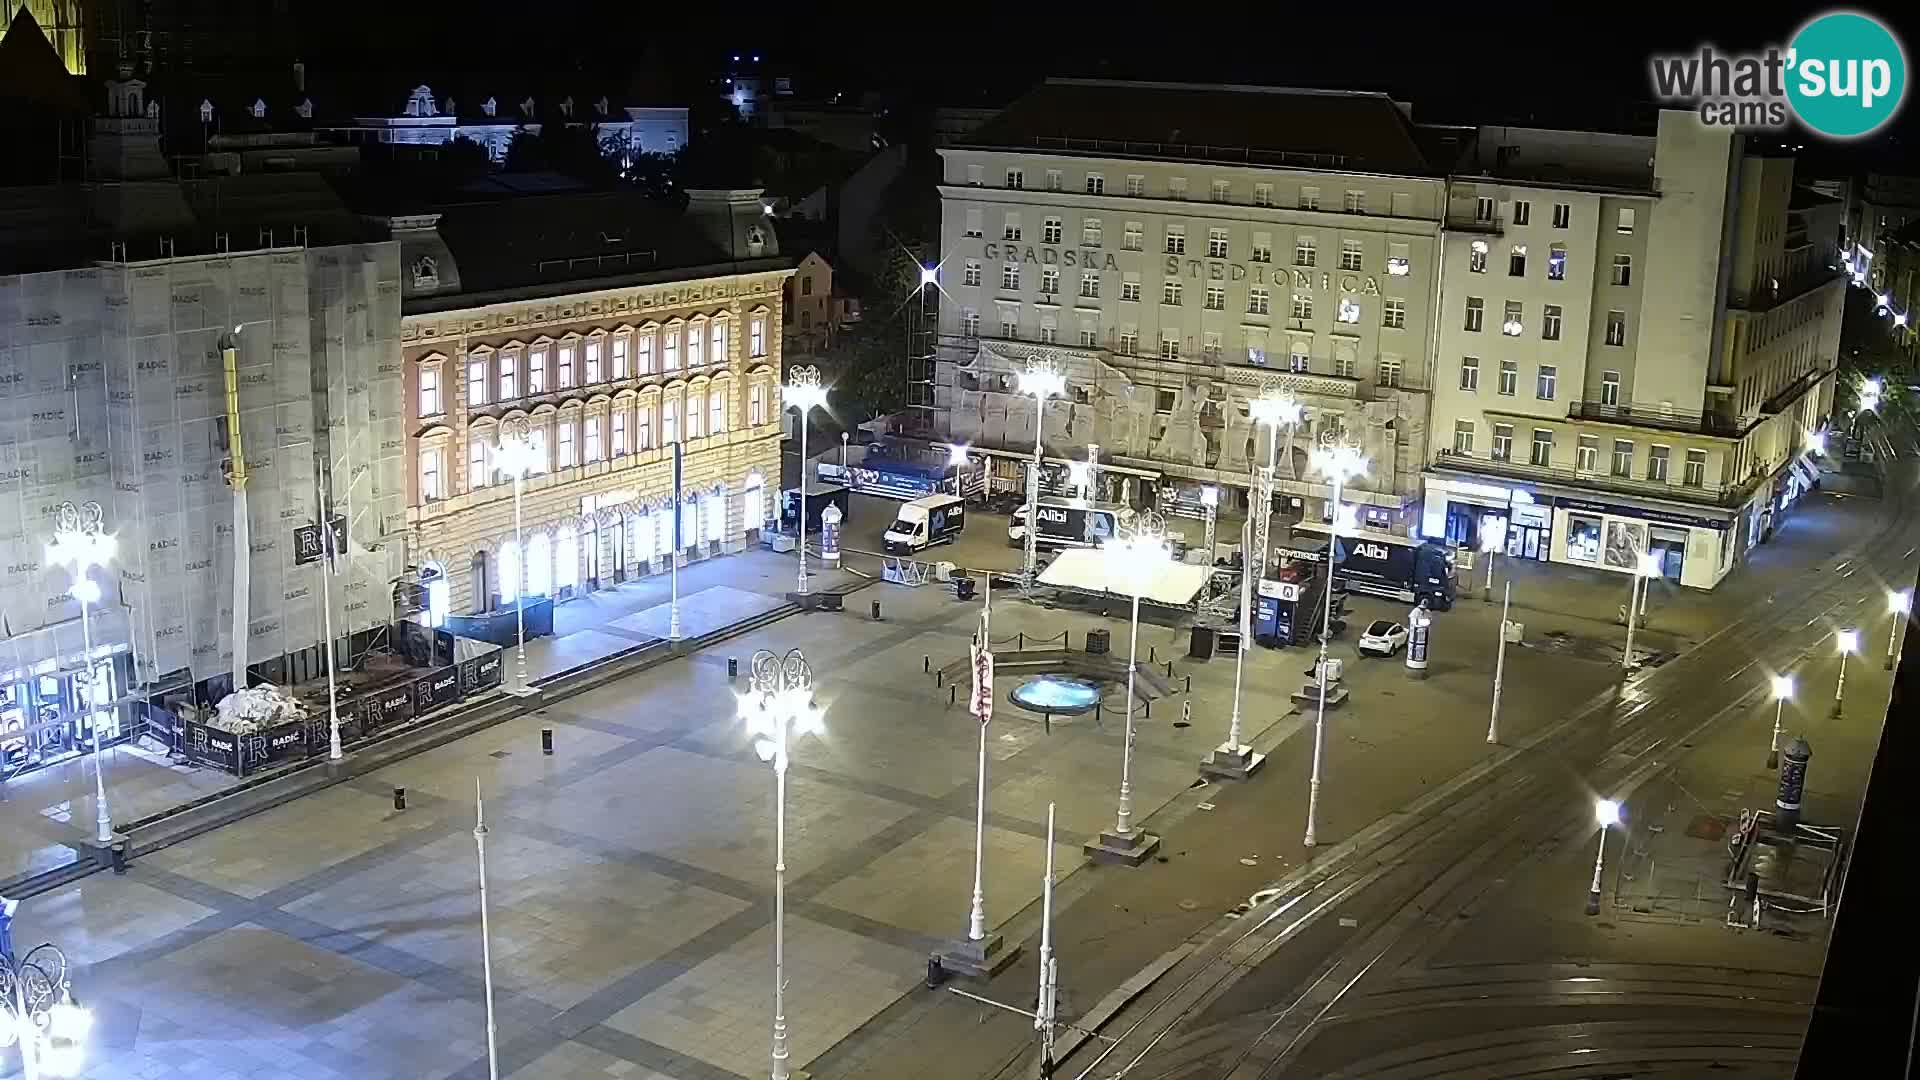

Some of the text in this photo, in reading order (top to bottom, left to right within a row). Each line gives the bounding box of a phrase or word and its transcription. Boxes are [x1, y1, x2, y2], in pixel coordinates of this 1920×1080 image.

[984, 243, 1119, 271] GRADSKA
[1036, 509, 1068, 523] Alibi
[1352, 543, 1389, 560] Alibi
